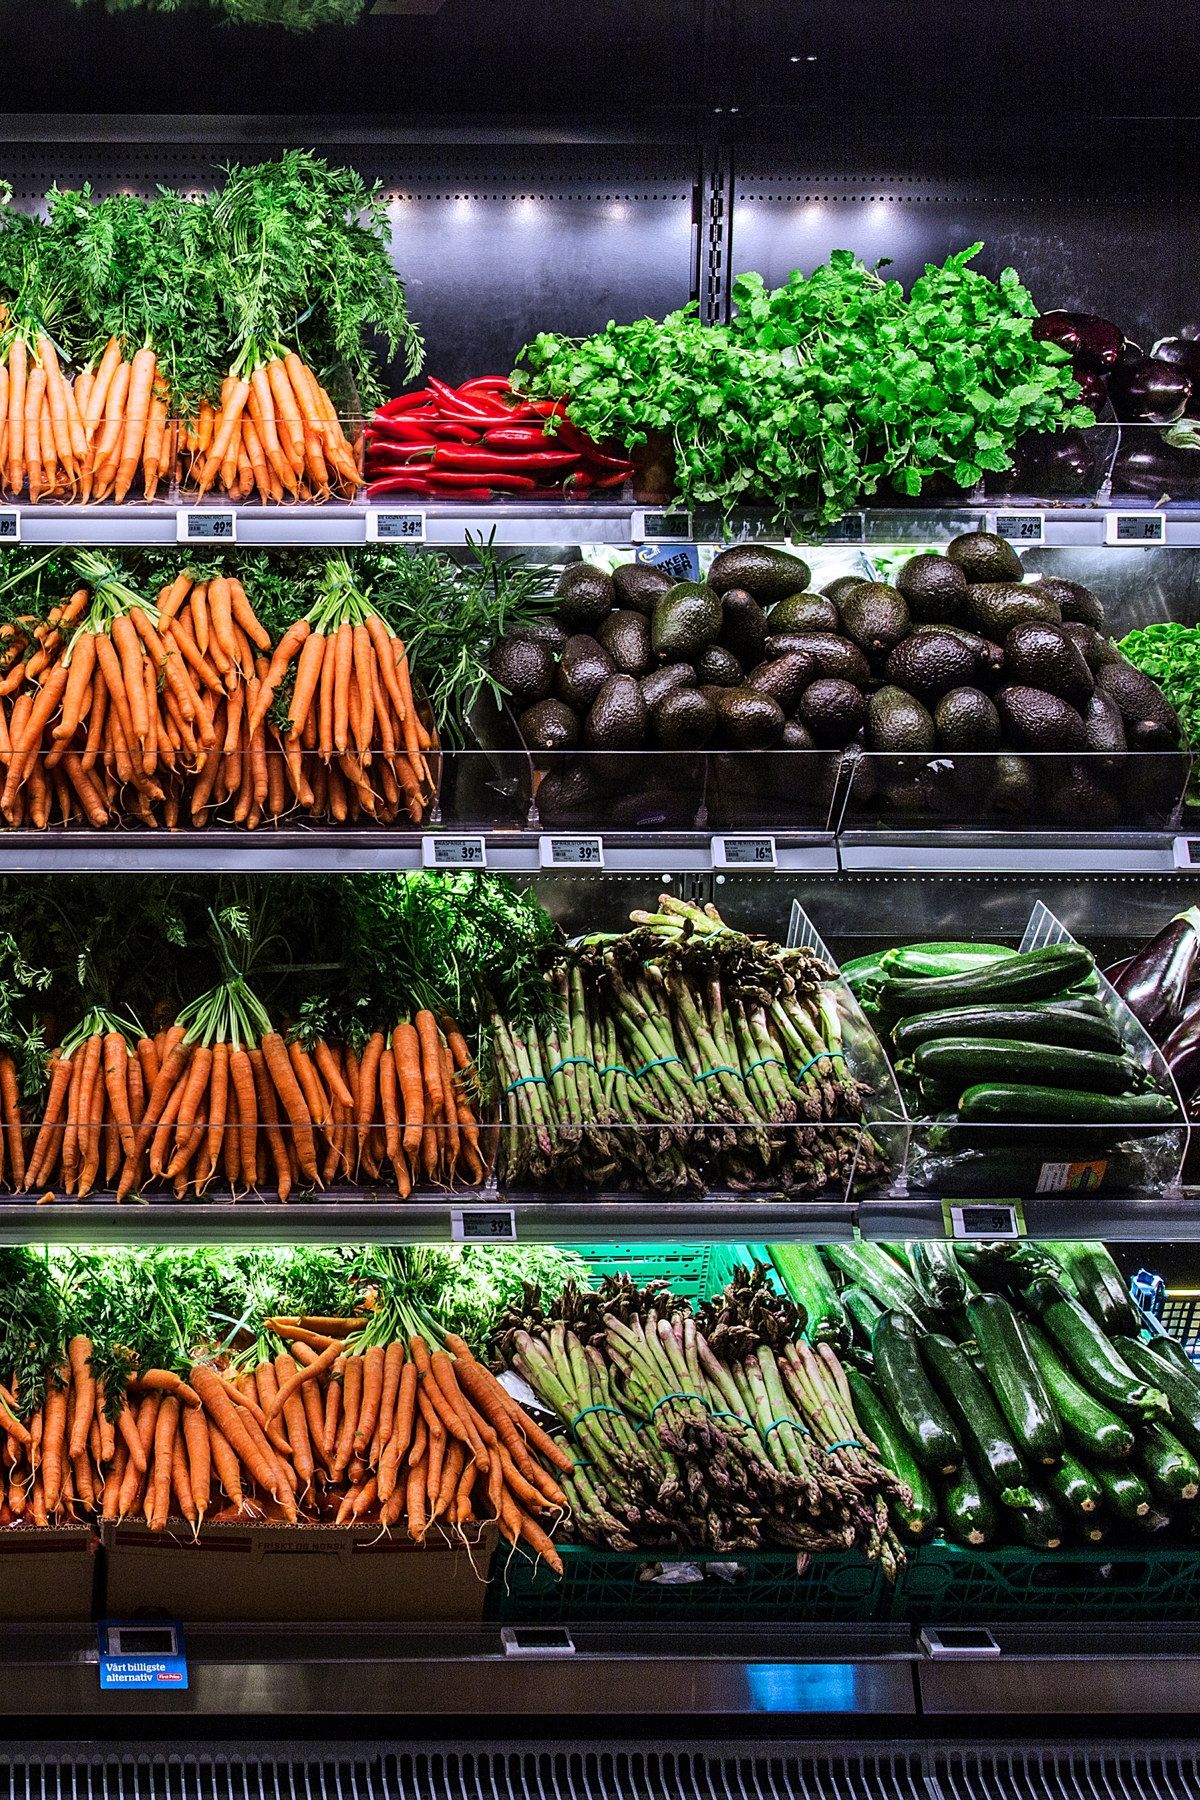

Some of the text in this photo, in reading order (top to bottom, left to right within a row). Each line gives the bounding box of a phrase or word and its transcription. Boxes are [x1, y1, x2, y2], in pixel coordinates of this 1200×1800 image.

[106, 1663, 166, 1673] Vårt billigste
[106, 1673, 153, 1682] alternativ
